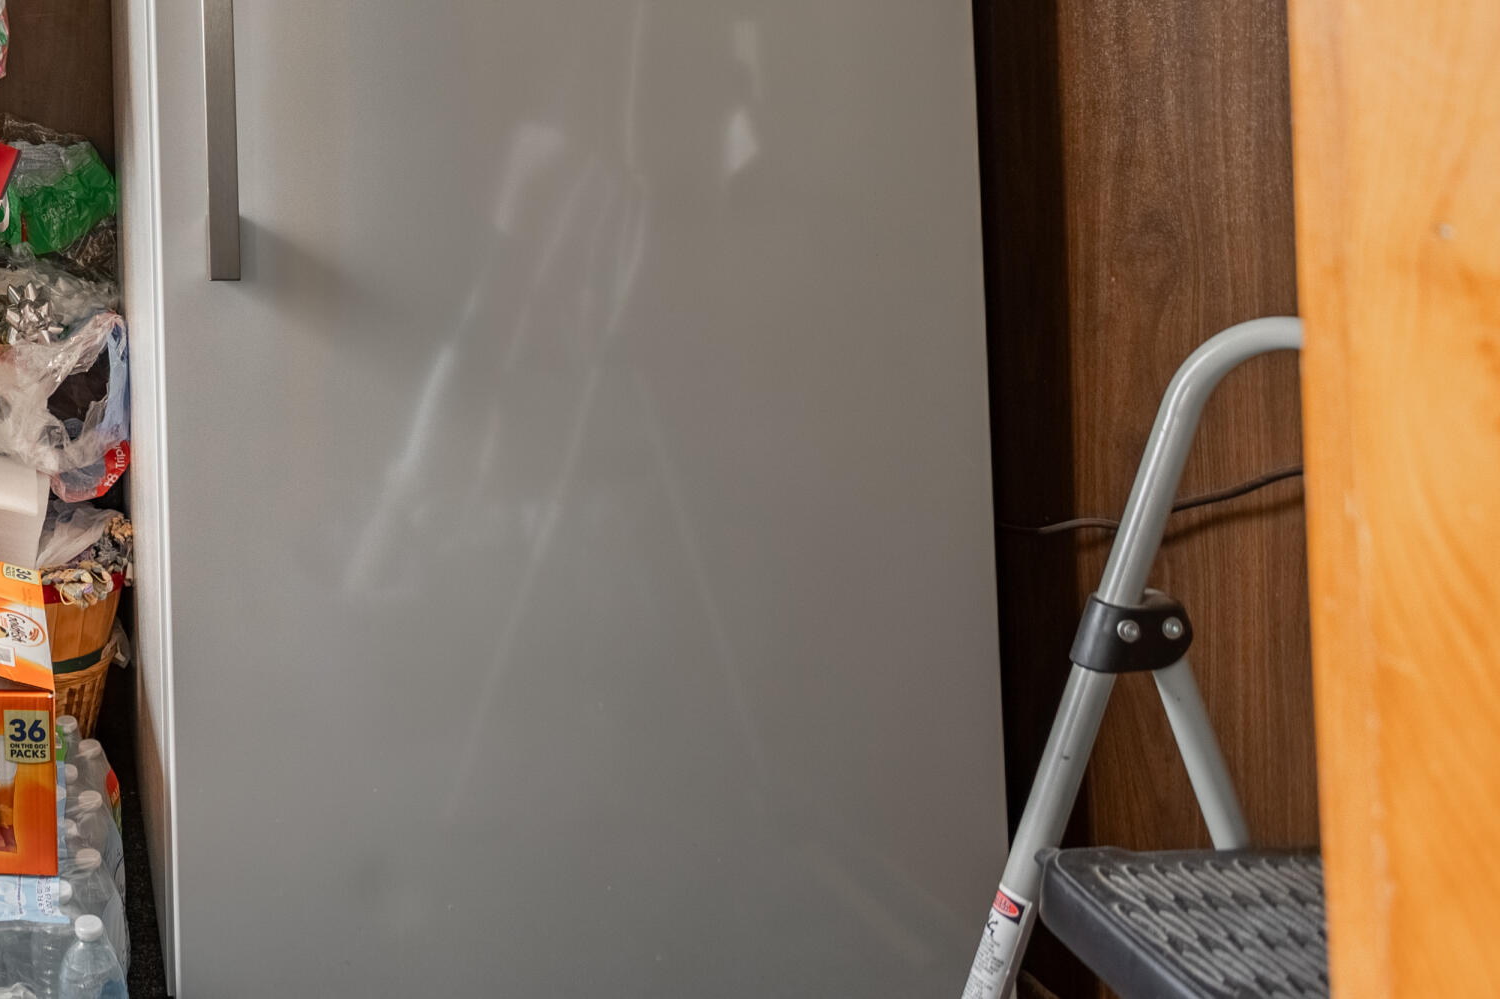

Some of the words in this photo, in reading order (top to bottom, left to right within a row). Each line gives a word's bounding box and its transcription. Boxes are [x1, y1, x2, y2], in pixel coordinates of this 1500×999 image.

[15, 567, 32, 580] 36
[8, 718, 46, 742] 36
[10, 749, 47, 758] PACKS
